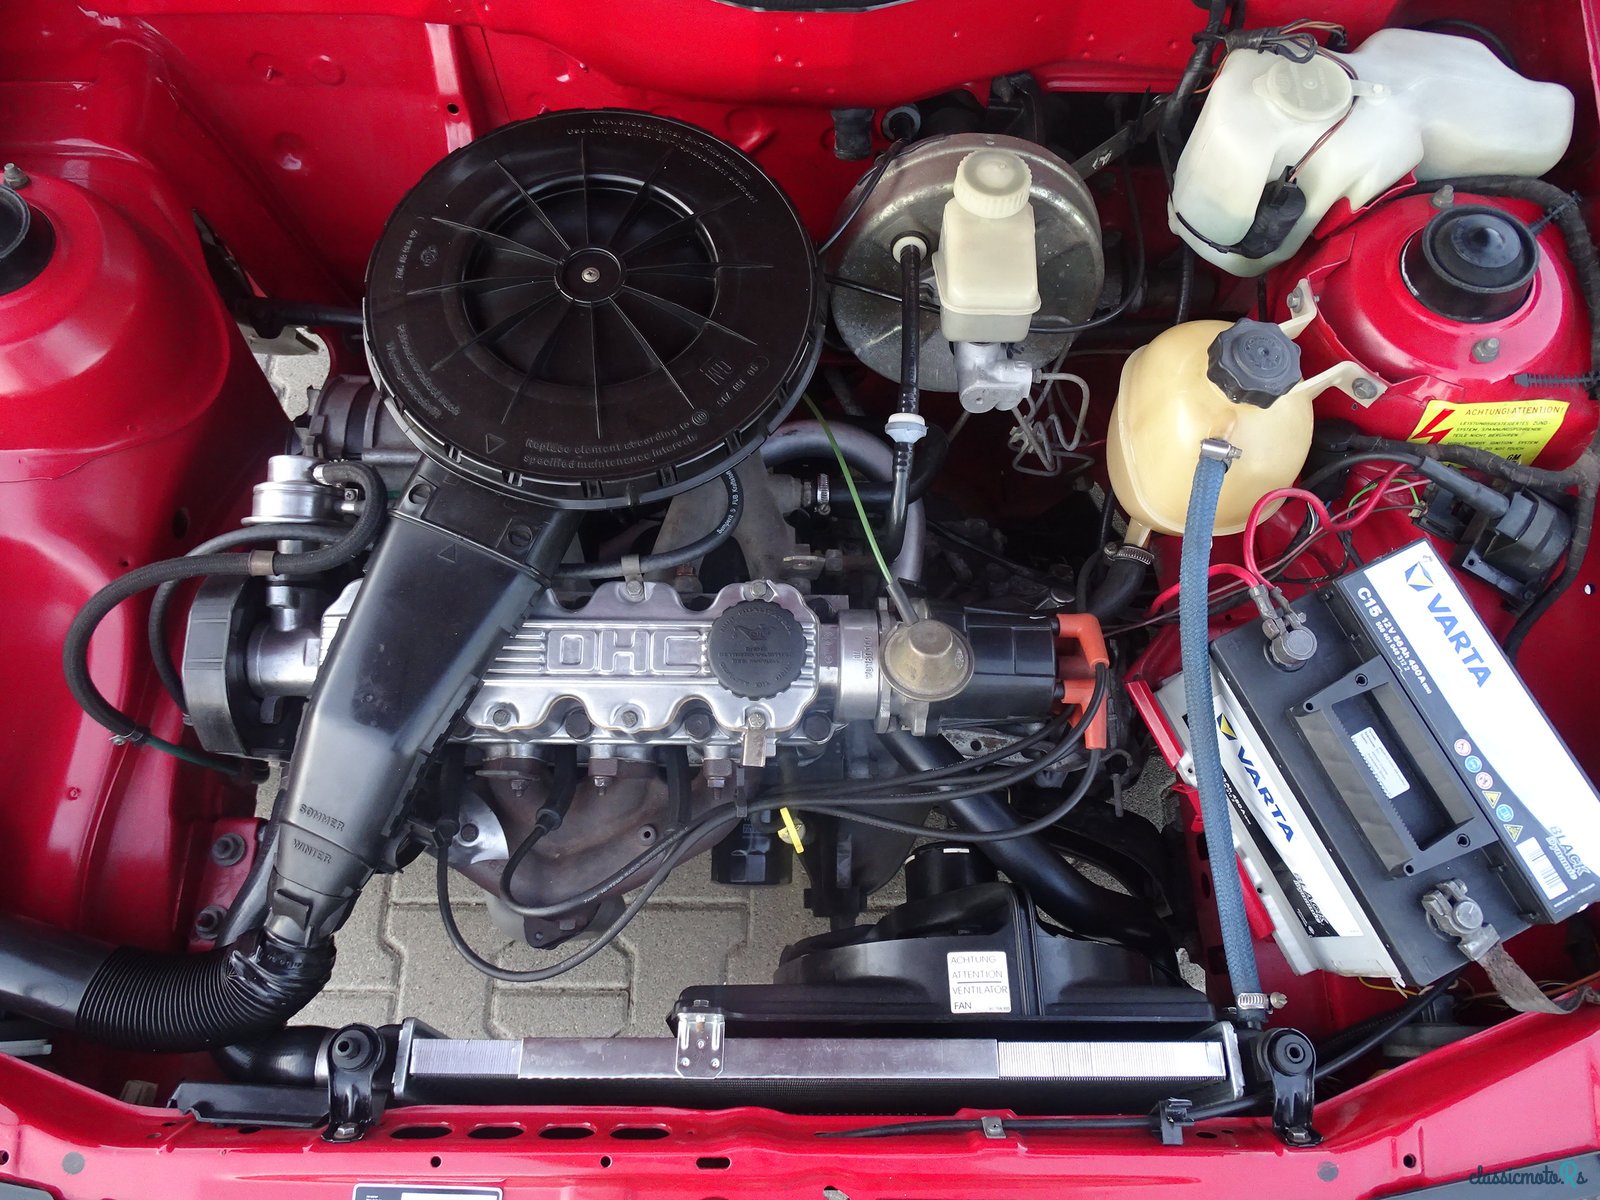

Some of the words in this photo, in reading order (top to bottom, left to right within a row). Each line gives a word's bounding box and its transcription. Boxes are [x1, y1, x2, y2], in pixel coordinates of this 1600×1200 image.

[1356, 586, 1383, 619] C15
[1380, 616, 1397, 636] 12V
[547, 629, 703, 675] OHC
[1426, 593, 1493, 689] VARTA
[1238, 746, 1295, 843] VARTA
[299, 803, 345, 832] SOMMER
[293, 838, 332, 864] WINTER
[1549, 824, 1590, 878] BLACK
[951, 956, 996, 964] ACHTUNG
[952, 970, 1003, 978] ATTENTION
[952, 986, 1008, 995] VENTILATOR
[954, 1002, 972, 1010] FAN
